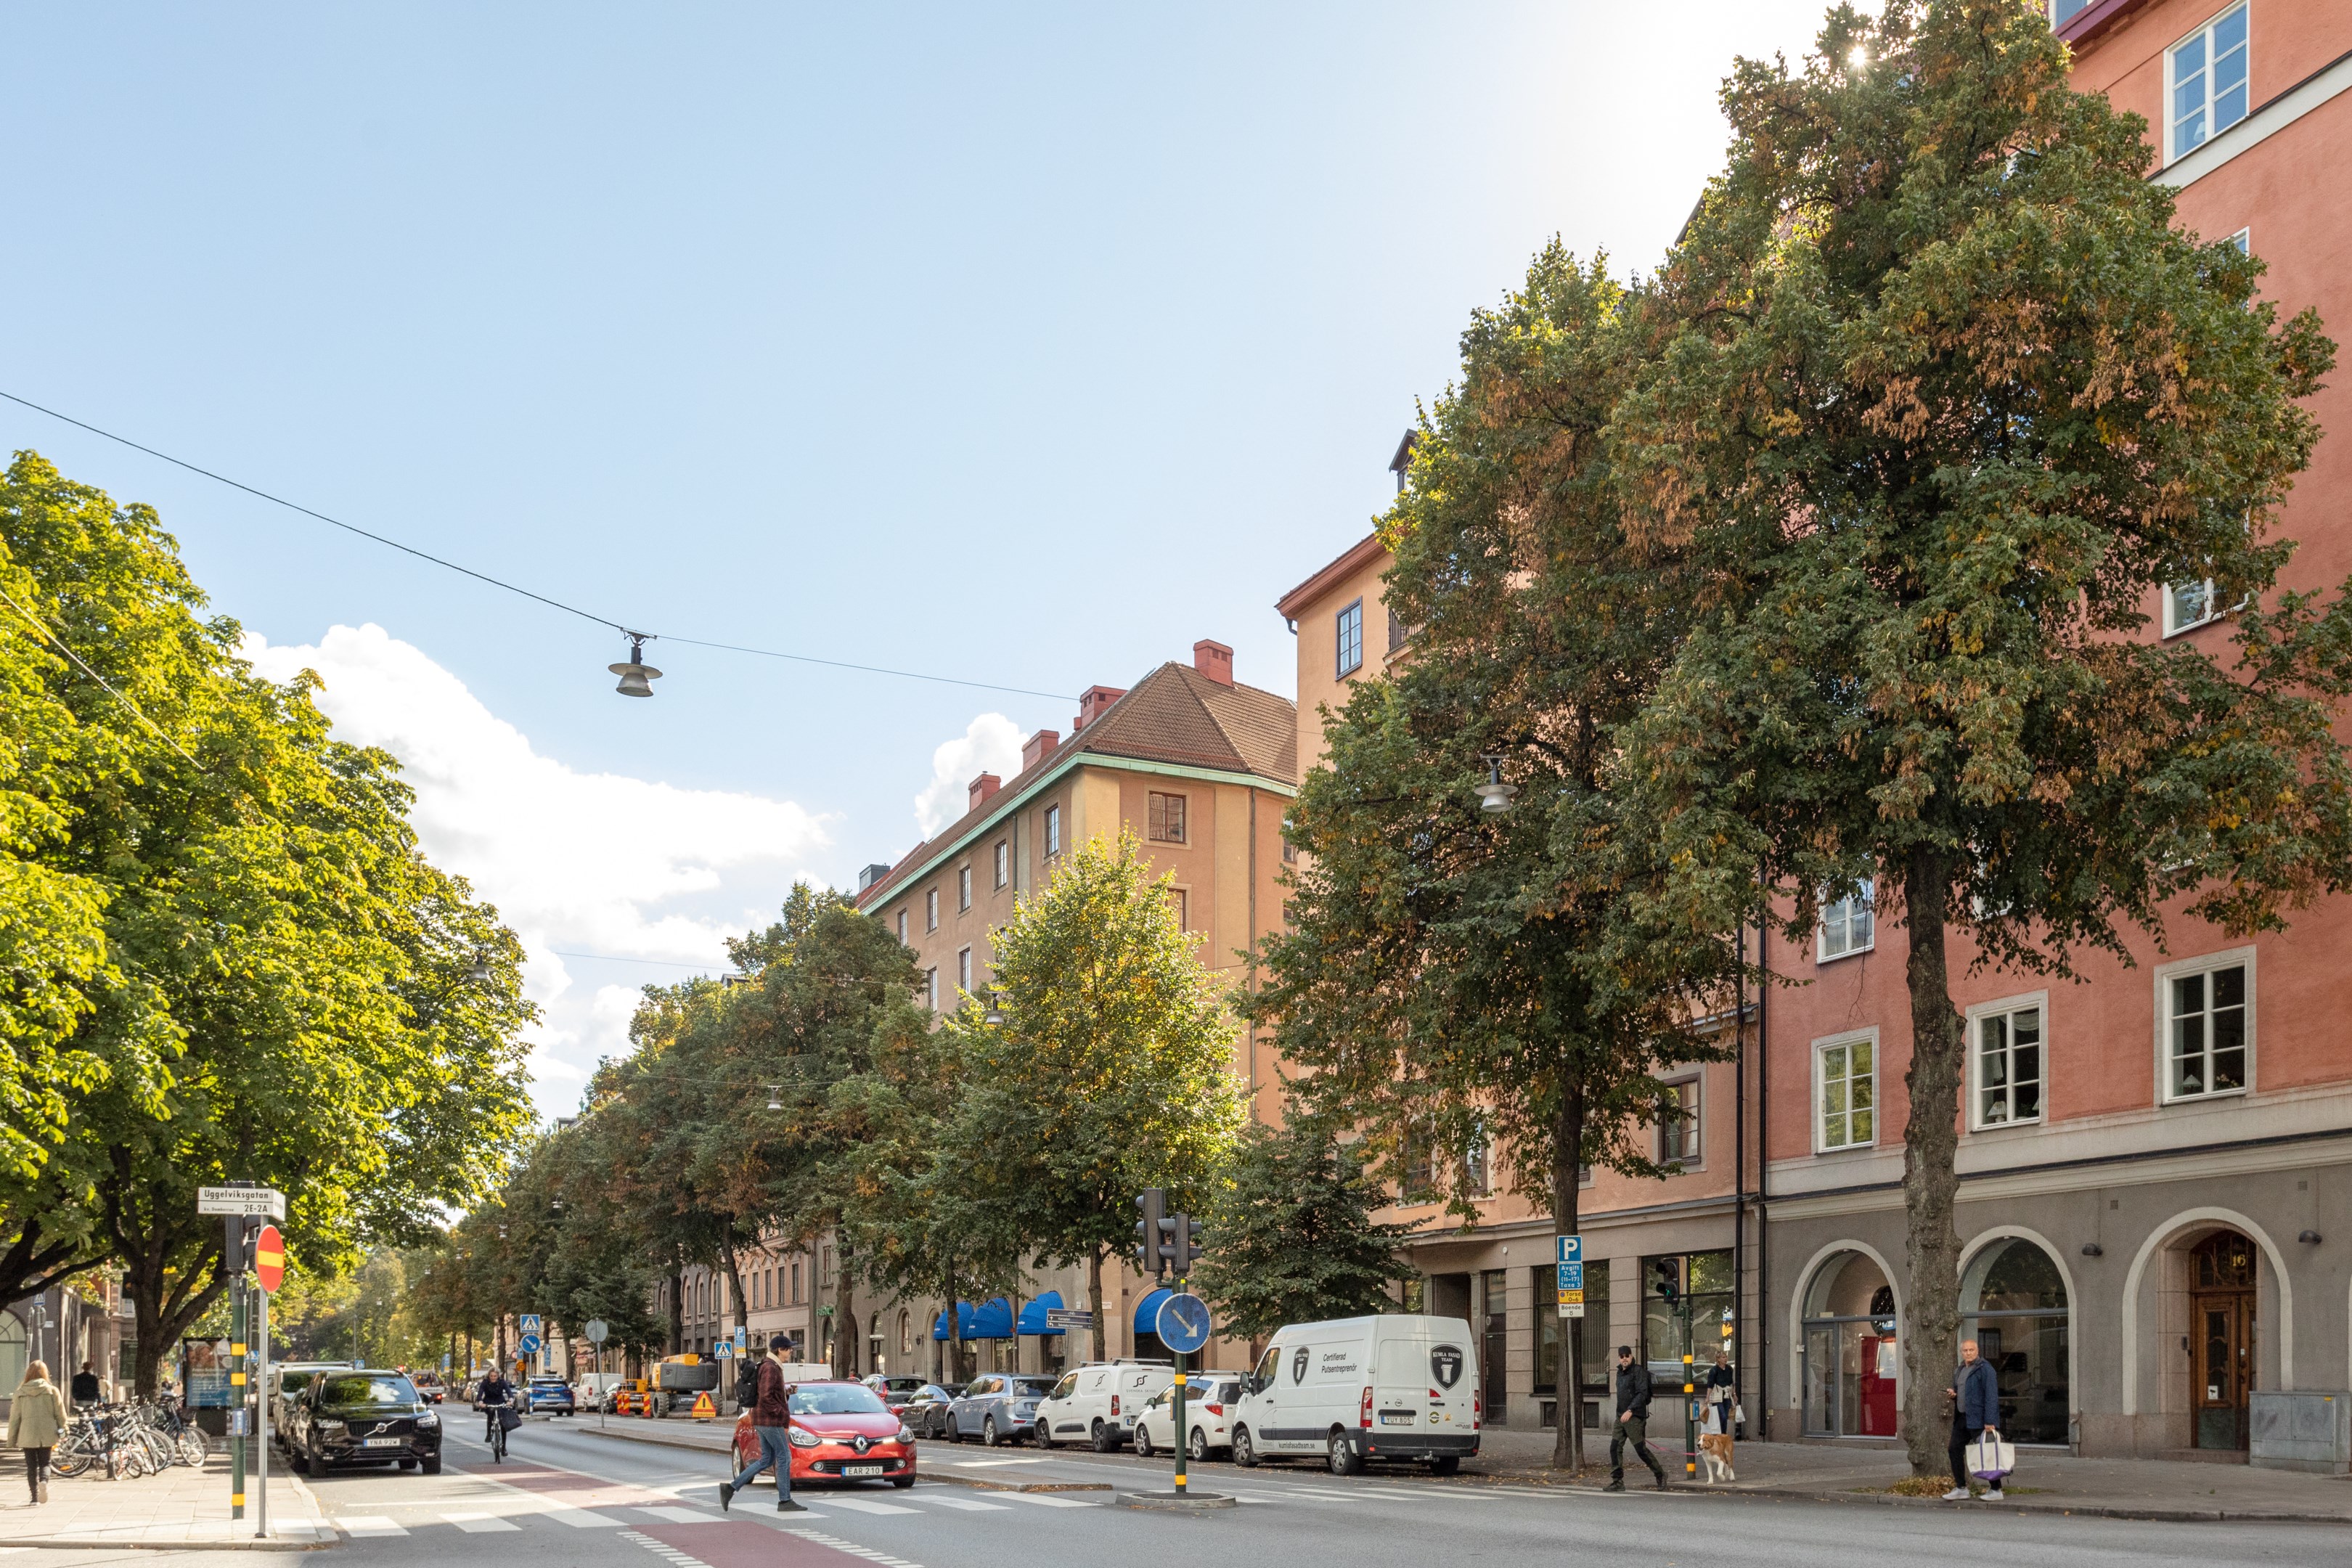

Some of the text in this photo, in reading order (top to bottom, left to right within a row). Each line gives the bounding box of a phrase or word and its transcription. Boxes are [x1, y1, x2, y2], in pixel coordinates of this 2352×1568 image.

[204, 1190, 269, 1200] Uggelviksgatan
[1564, 1238, 1578, 1260] P
[2232, 1254, 2246, 1266] 16
[1323, 1352, 1347, 1362] Certifierad
[1321, 1363, 1357, 1374] Putsentreprenör
